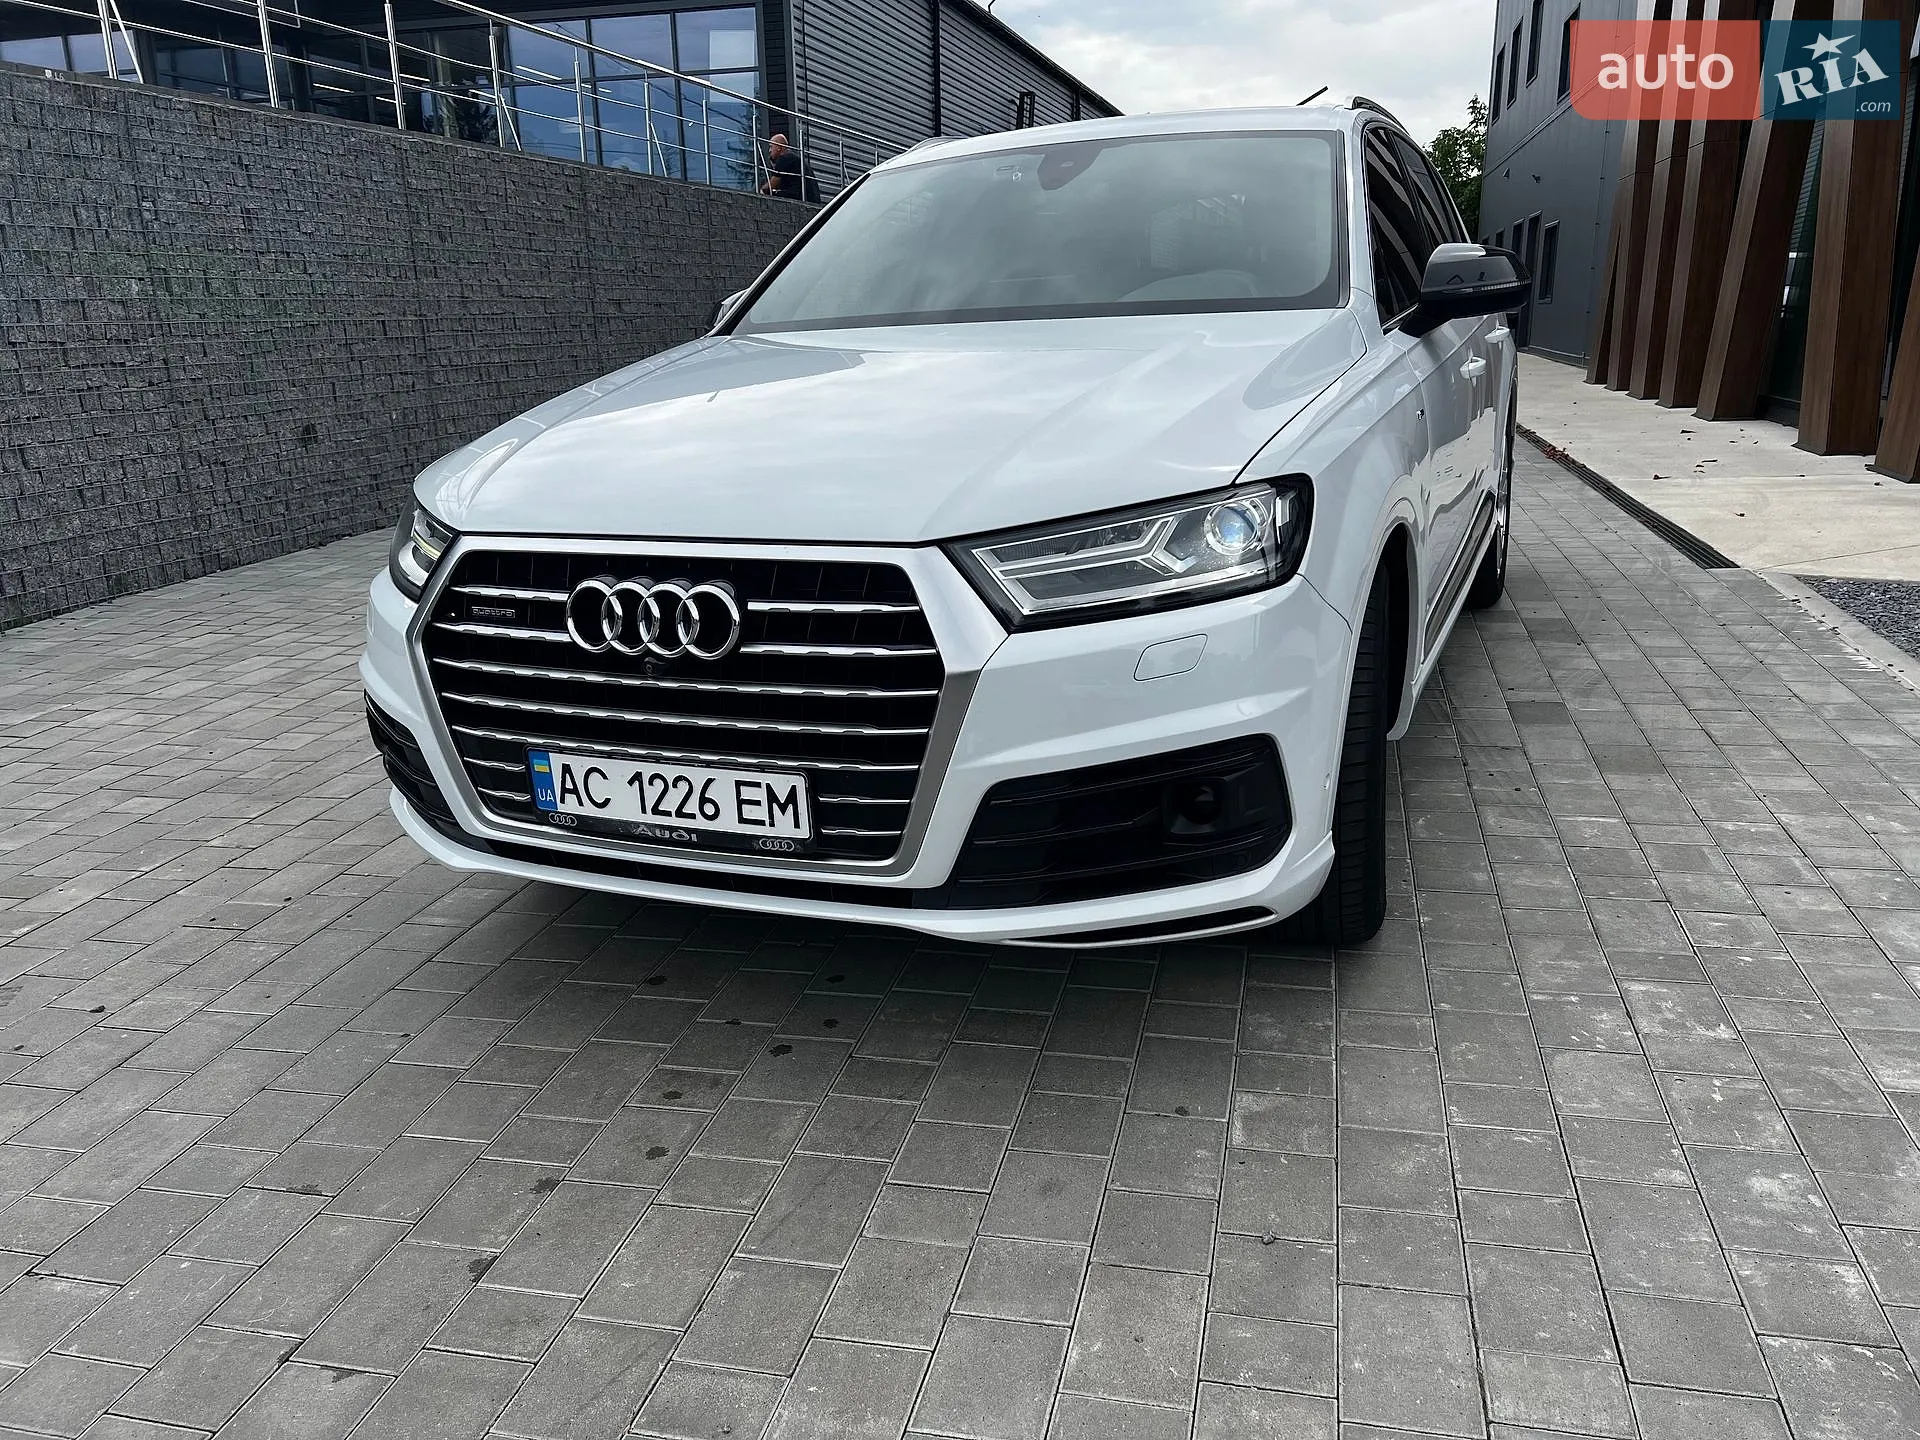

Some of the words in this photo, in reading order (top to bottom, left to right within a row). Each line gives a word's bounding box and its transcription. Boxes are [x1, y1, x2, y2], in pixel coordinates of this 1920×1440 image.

[537, 788, 555, 802] UA
[559, 763, 612, 809] AC
[626, 771, 721, 822] 1226
[734, 779, 801, 829] EM
